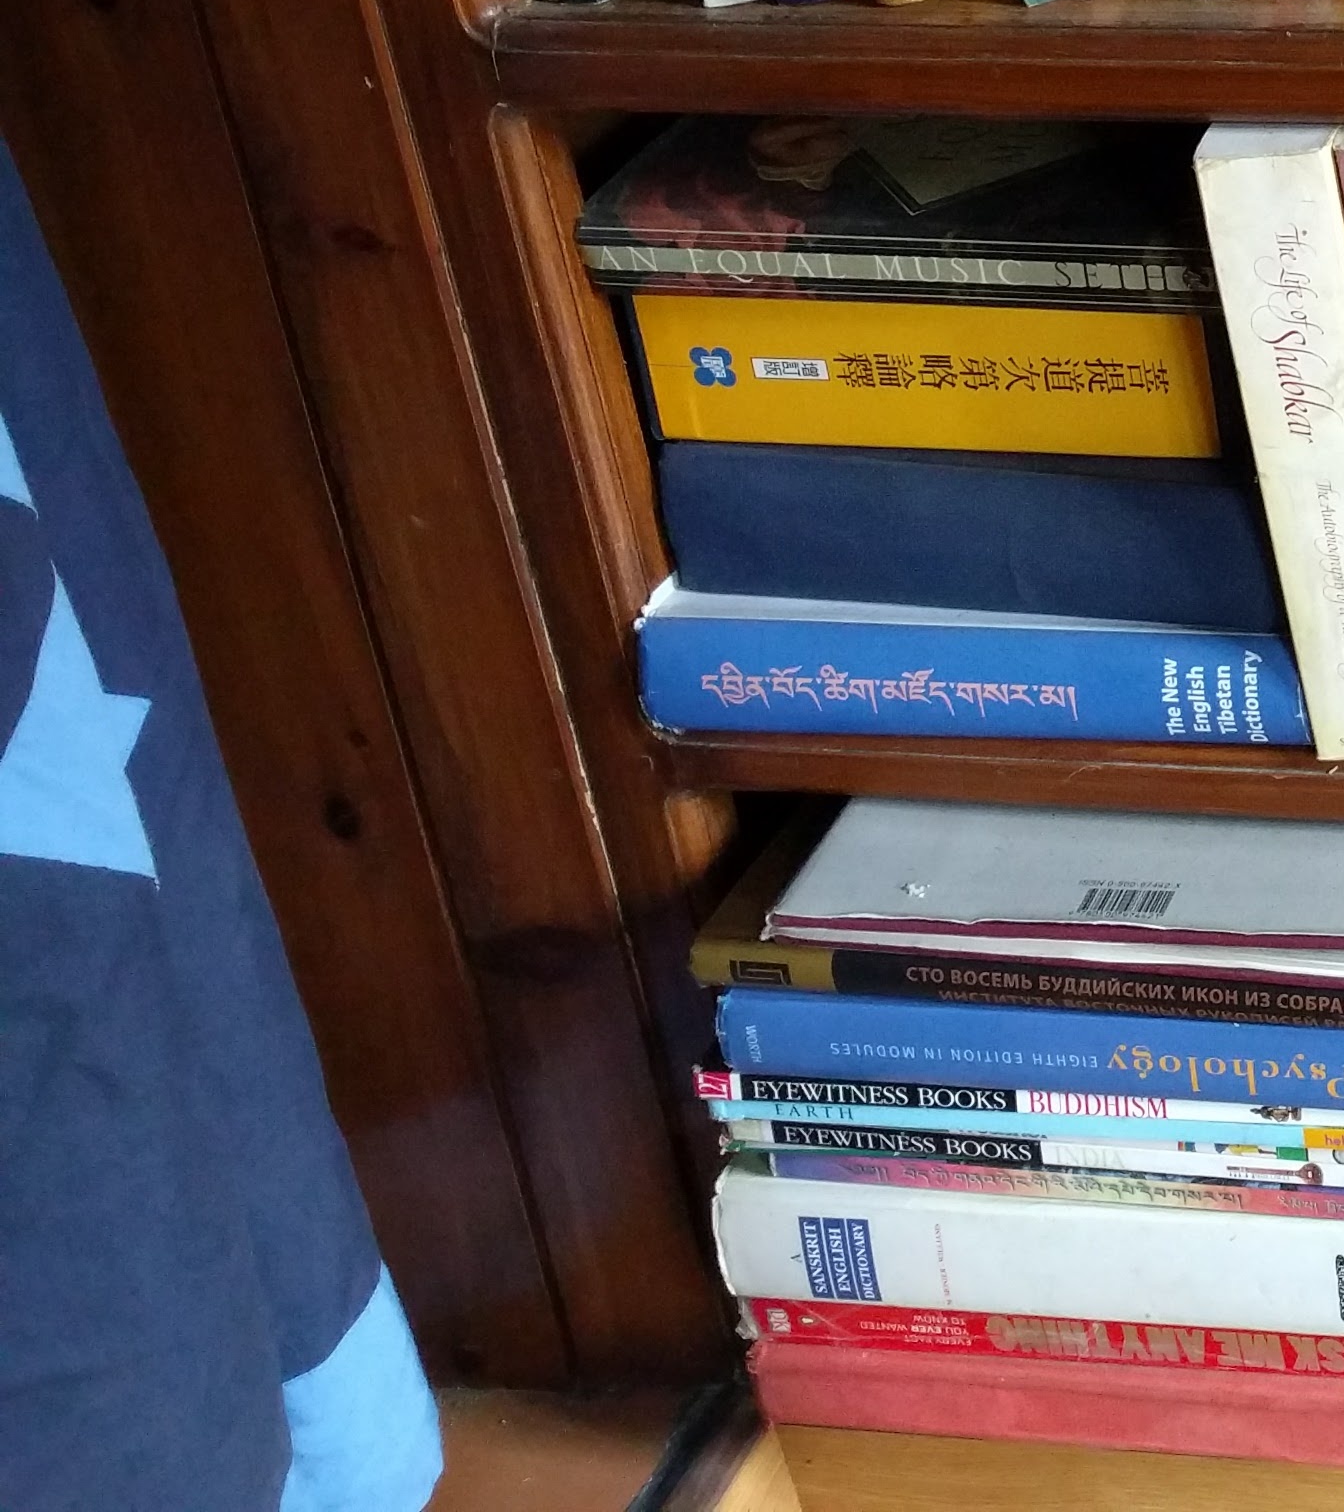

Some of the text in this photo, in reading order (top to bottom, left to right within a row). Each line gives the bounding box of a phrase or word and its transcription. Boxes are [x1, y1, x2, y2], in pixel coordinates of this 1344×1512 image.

[599, 245, 1170, 291] AN EQUAL MUSIC SETH
[836, 351, 1170, 396] 菩提道次第略論釋
[1163, 657, 1185, 736] The New
[1192, 665, 1211, 734] English
[1220, 664, 1238, 736] Tibetan
[1249, 648, 1270, 743] Dictionary
[906, 965, 945, 986] СТО
[950, 968, 1033, 992] ВОСЕМЬ
[1038, 973, 1176, 1000] БУДДИЙСКИХ
[1181, 982, 1235, 1003] ИКОН
[1240, 987, 1271, 1006] ИЗ
[751, 1078, 1169, 1119] EYEWITNESS BOOKS BUDDHISM
[774, 1103, 856, 1121] EARTH
[802, 1221, 828, 1296] SANSKRIT
[826, 1227, 852, 1293] ENGLISH
[849, 1221, 878, 1301] DICTIONARY
